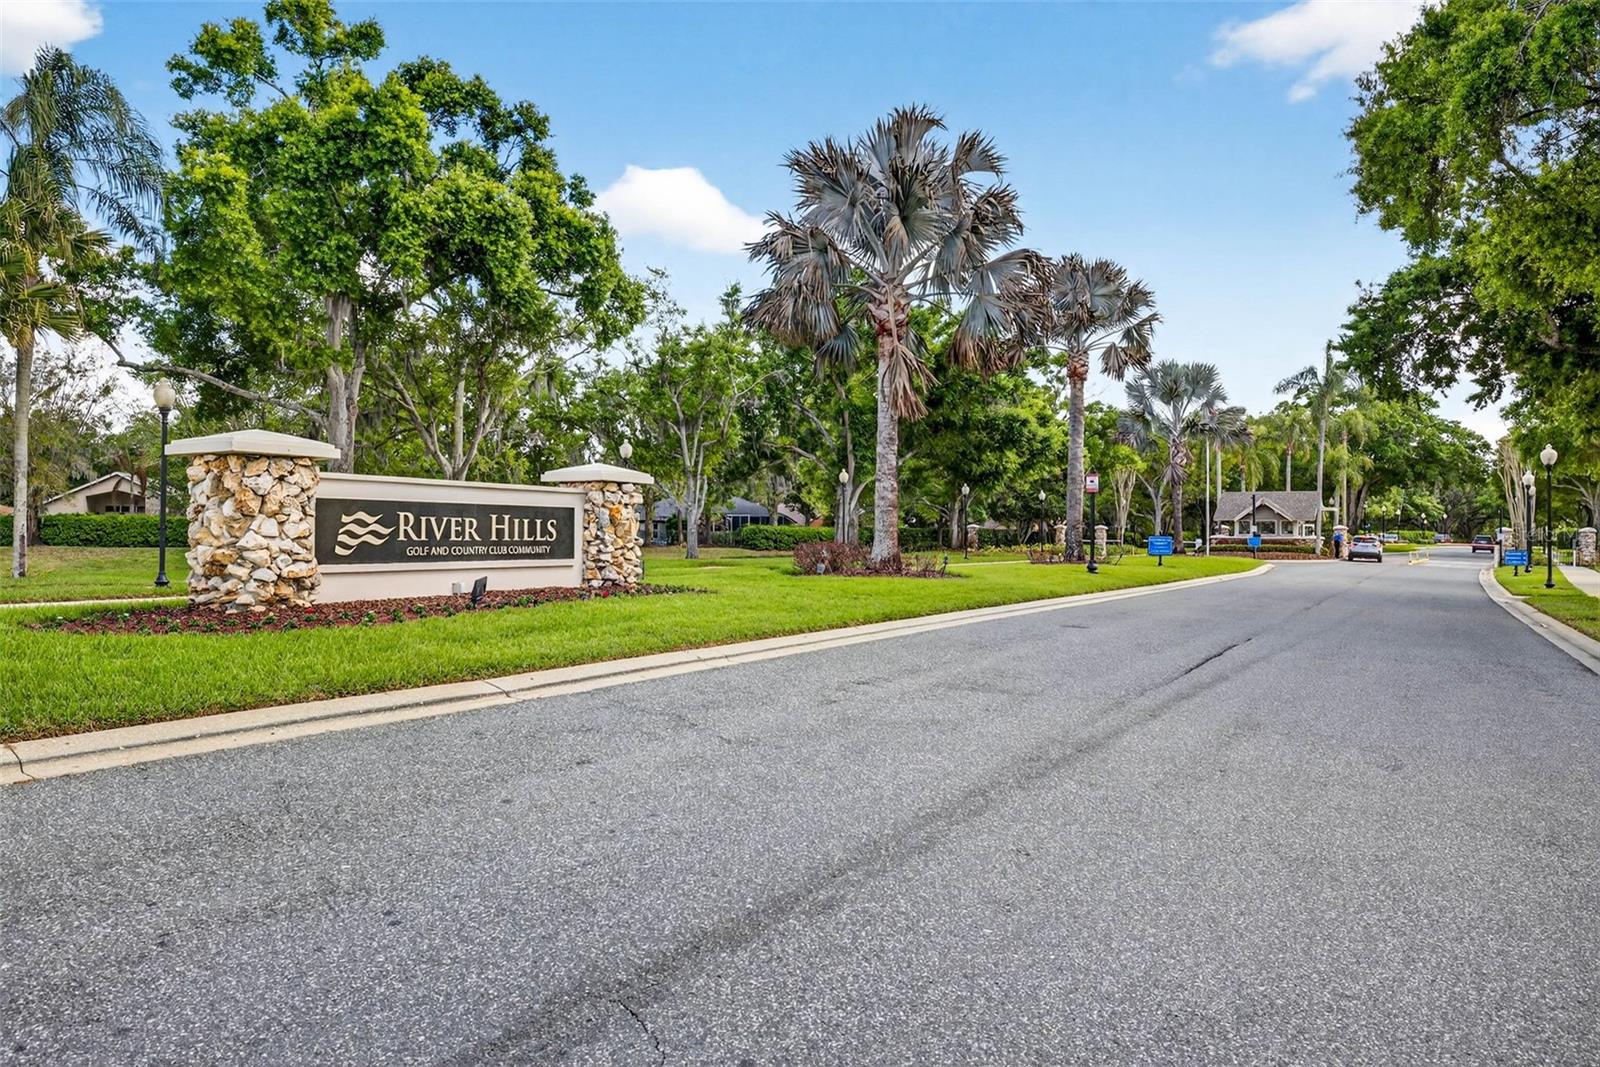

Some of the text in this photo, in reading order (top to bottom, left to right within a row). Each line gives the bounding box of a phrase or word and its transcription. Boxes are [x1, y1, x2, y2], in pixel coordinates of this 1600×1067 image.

[396, 511, 557, 541] RIVER HILLS
[406, 545, 551, 556] GOLF AND COUNTRY CLUB COMMUNITY
